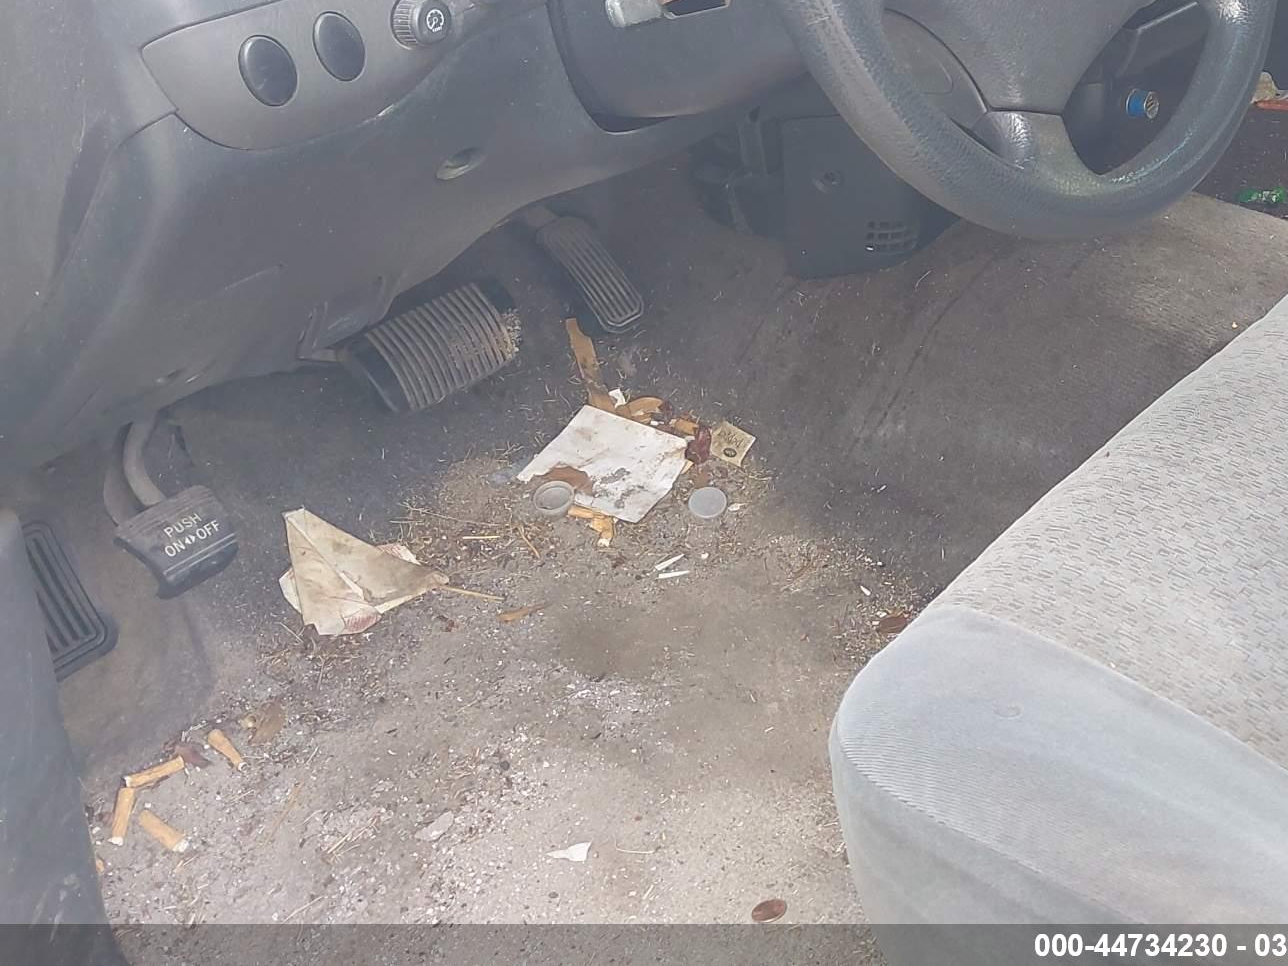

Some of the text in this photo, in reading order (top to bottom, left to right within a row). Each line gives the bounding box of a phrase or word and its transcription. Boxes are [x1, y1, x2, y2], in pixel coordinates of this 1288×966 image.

[163, 513, 202, 538] PUSH
[164, 519, 221, 558] ON OFF
